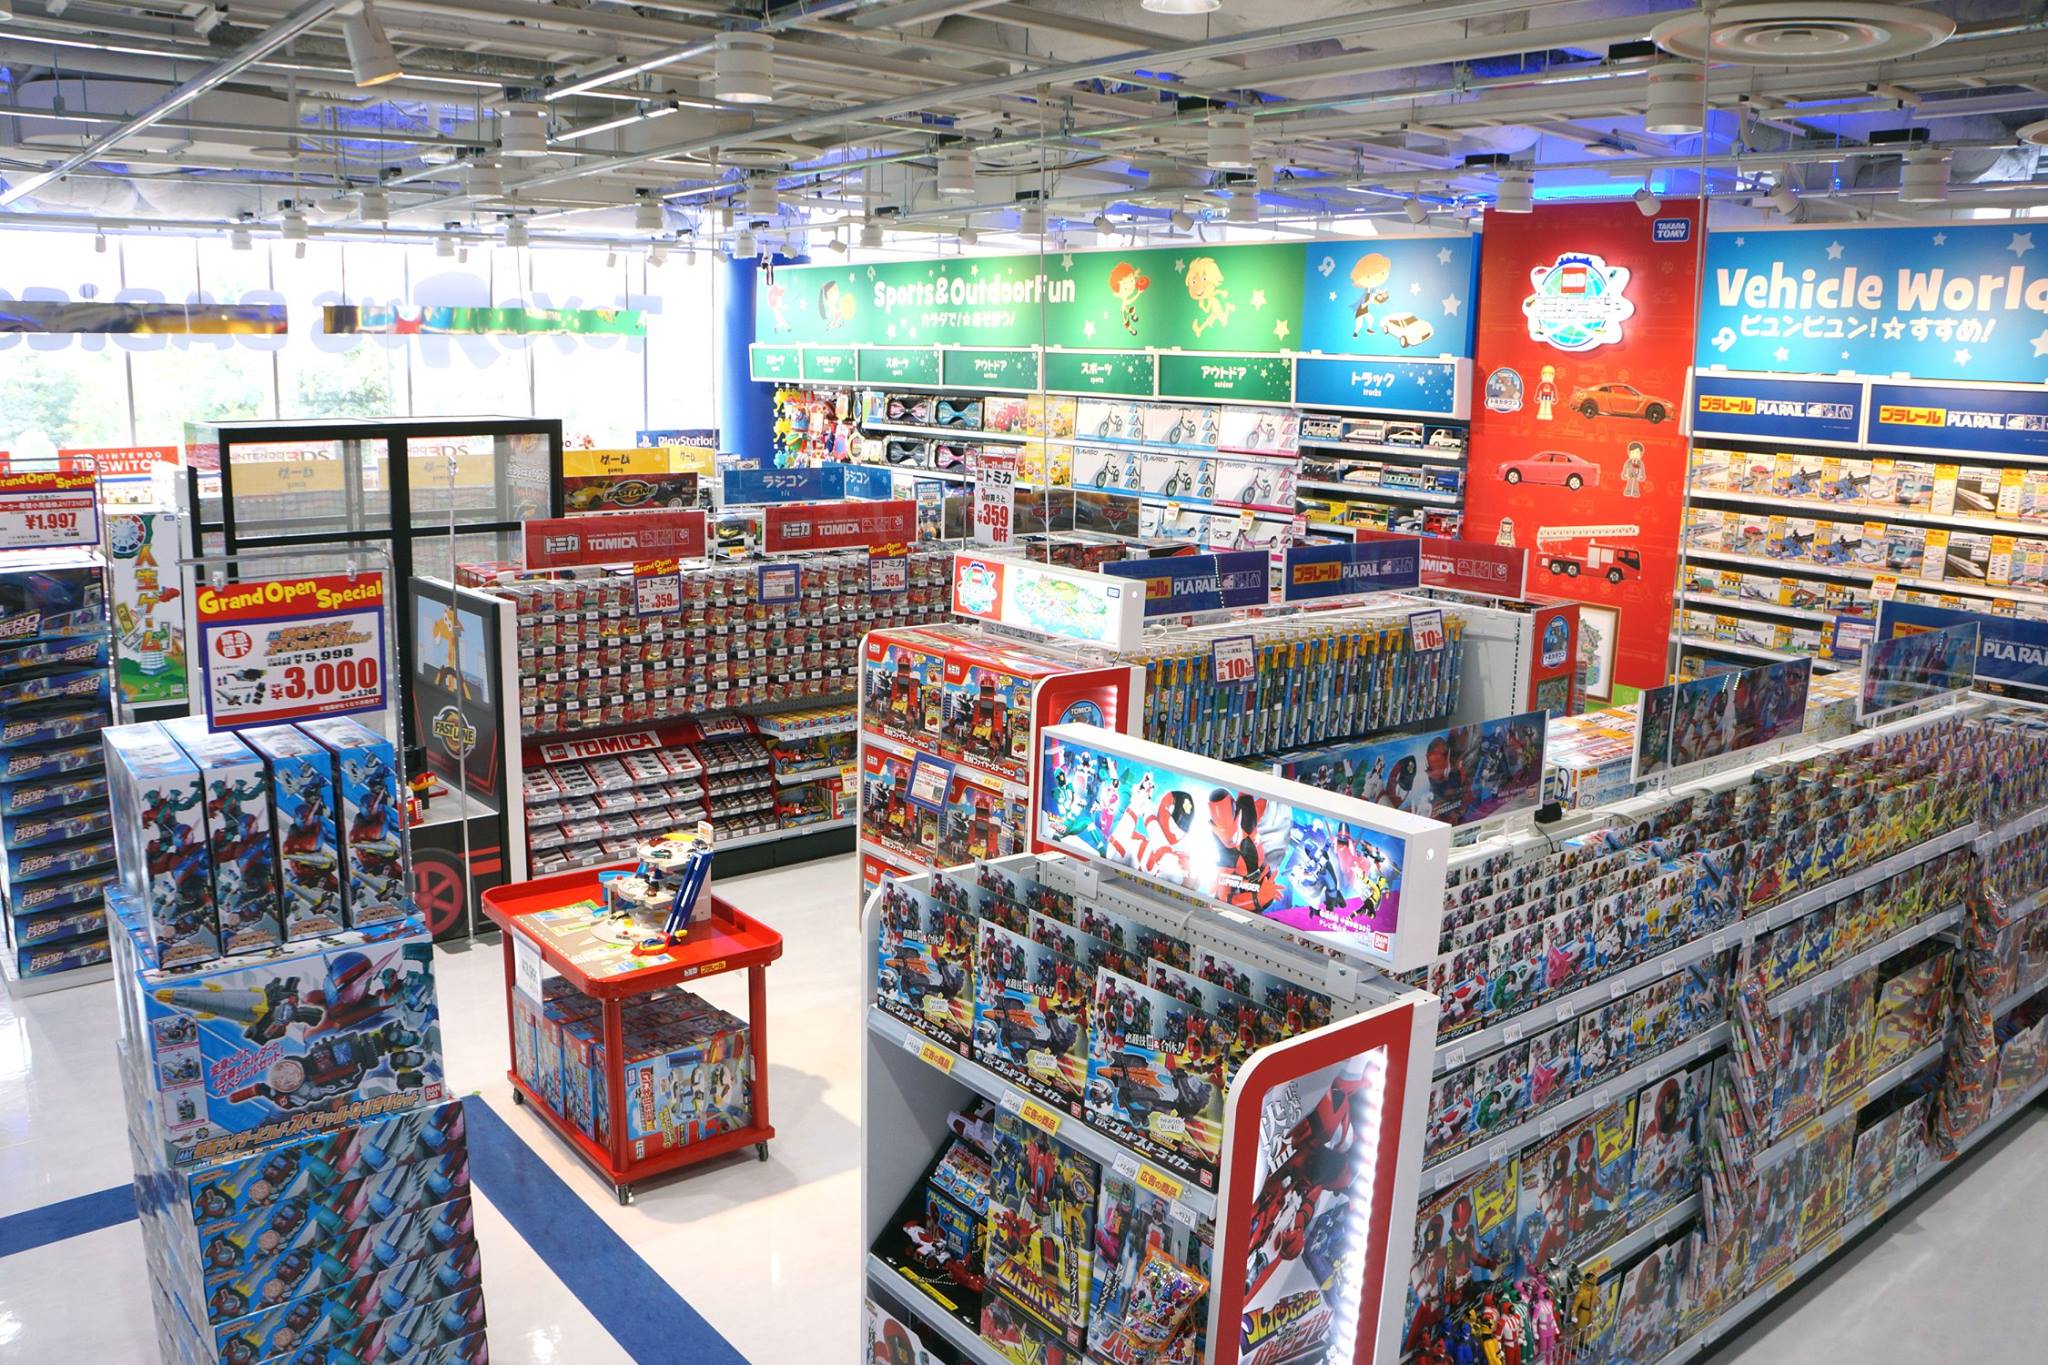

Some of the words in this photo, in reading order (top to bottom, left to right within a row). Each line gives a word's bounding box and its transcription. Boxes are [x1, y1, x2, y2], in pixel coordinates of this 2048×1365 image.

[1656, 229, 1686, 238] TOMY
[1657, 222, 1686, 231] TAKARA
[1717, 262, 1883, 310] Vehicle
[974, 358, 1008, 371] アウトドア
[1080, 362, 1112, 375] スポーツ
[1200, 365, 1247, 380] アウトドア
[1351, 371, 1395, 388] トラック
[1700, 397, 1752, 413] プラレール
[1881, 407, 1940, 425] プラレール
[658, 435, 715, 448] PlayStation
[97, 451, 162, 461] NINTENDO
[601, 454, 630, 465] ゲーム
[100, 458, 165, 473] SWITC
[277, 466, 314, 479] ゲーム
[26, 472, 57, 485] Open
[56, 475, 96, 489] Special
[763, 475, 807, 488] ラジコン
[985, 470, 1012, 485] トミカ
[25, 512, 77, 530] ¥1,997
[783, 522, 811, 538] トミカ
[817, 523, 860, 535] TOMICA
[992, 527, 1008, 543] OFF
[545, 536, 580, 553] トミカ
[588, 537, 638, 550] TOMICA
[882, 560, 904, 568] トミカ
[1343, 562, 1379, 578] PLARAIL
[1294, 563, 1340, 582] プラレール
[650, 577, 677, 588] トミカ
[135, 544, 160, 652] 人生ゲーム
[199, 587, 264, 614] Grand
[265, 581, 317, 604] Open
[316, 580, 383, 609] Special
[434, 721, 453, 735] FAST
[453, 725, 475, 743] LNE
[716, 718, 740, 731] 462
[570, 733, 655, 757] TOMICA
[701, 961, 726, 974] プラレール
[425, 1085, 441, 1093] BAN
[425, 1091, 438, 1100] DAI
[1023, 1106, 1057, 1131] 広告の商品
[1140, 1170, 1178, 1199] 広告の商品
